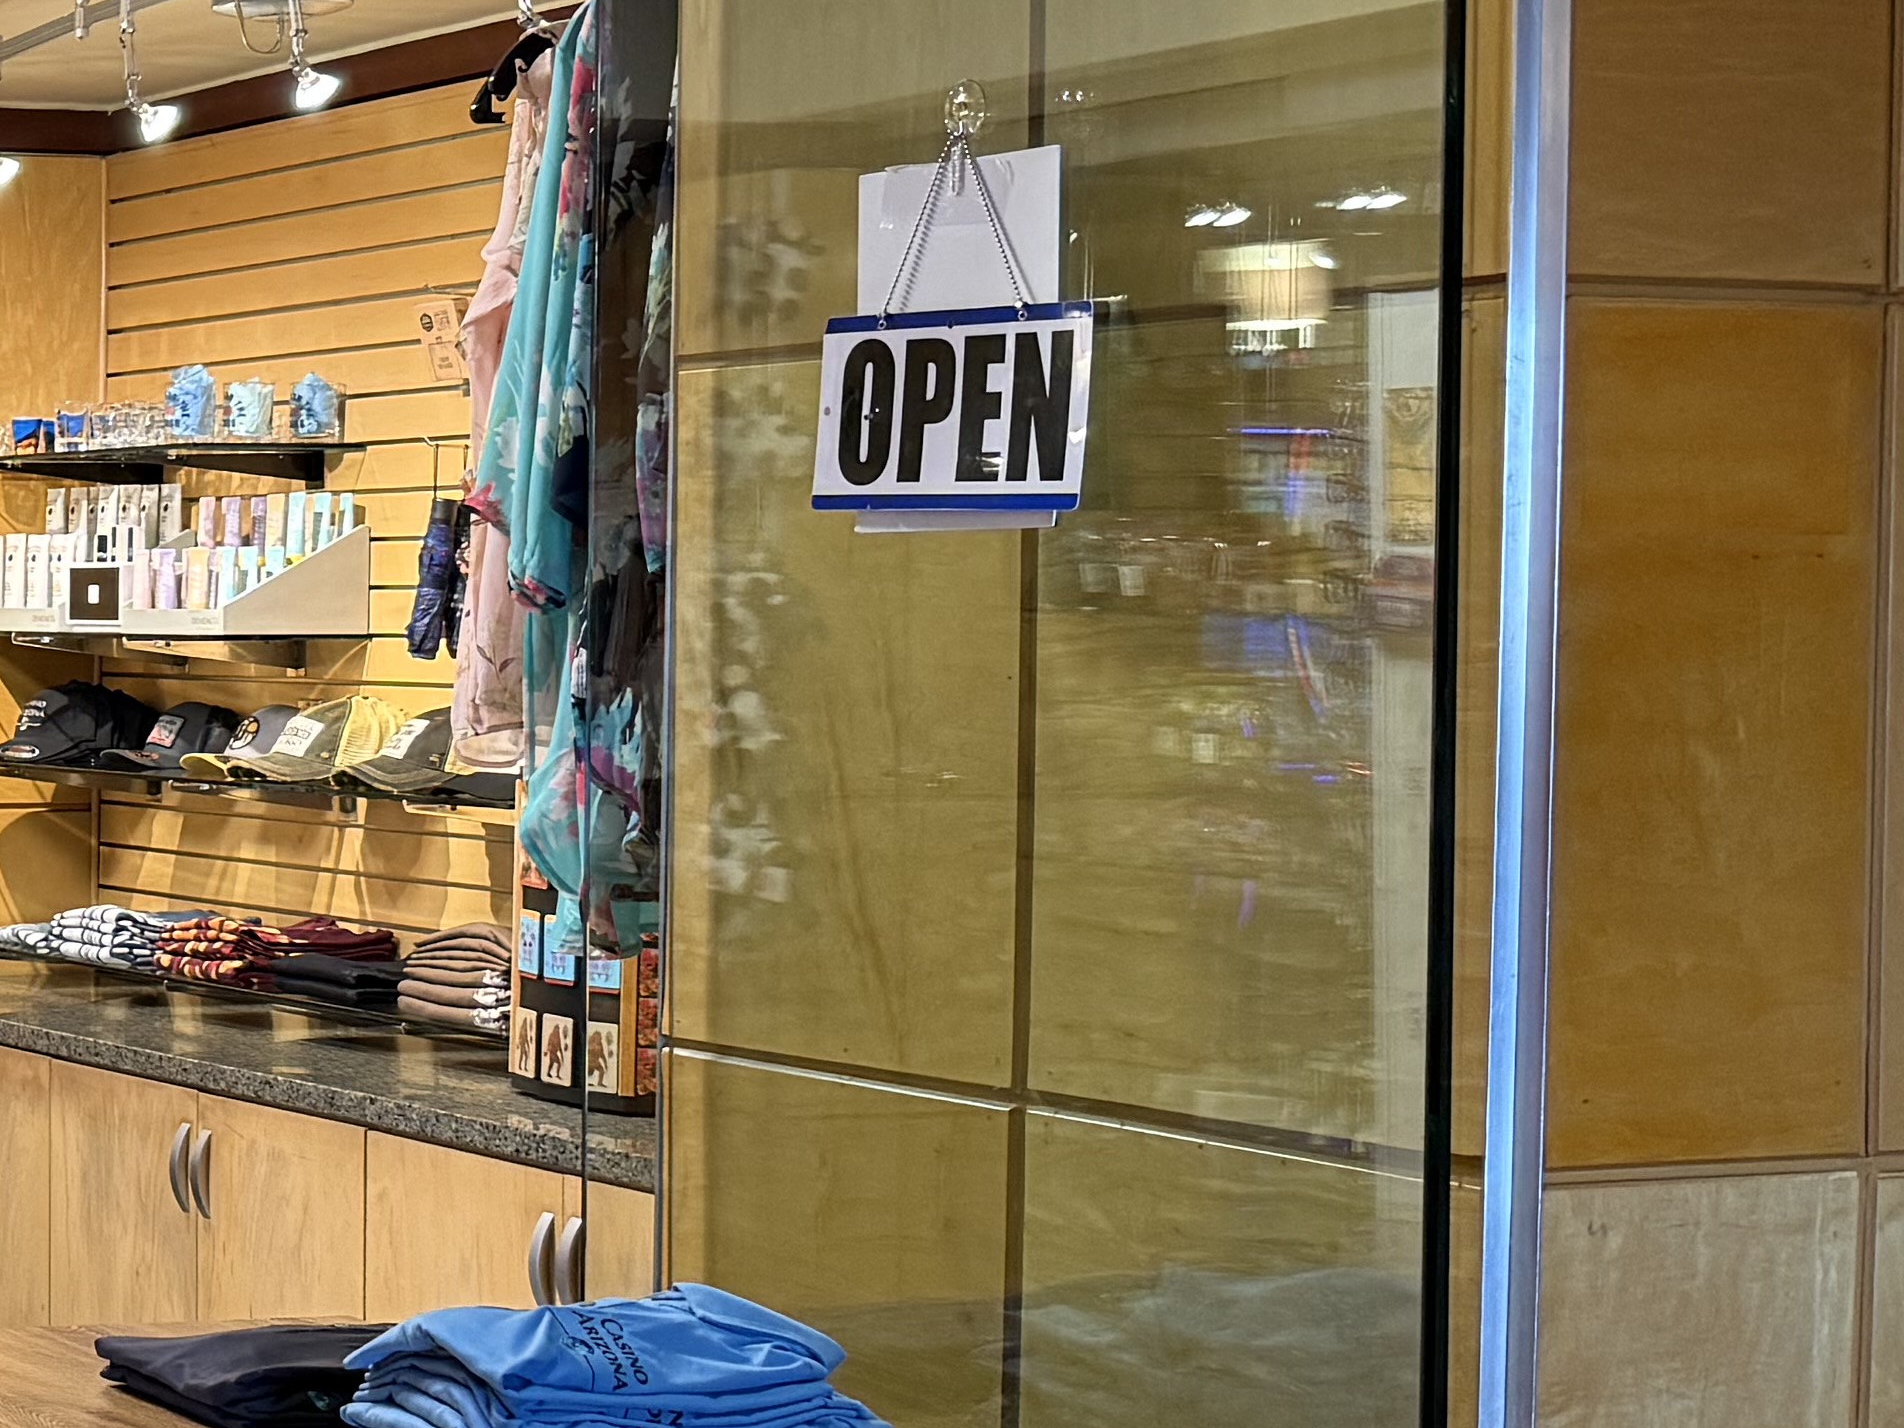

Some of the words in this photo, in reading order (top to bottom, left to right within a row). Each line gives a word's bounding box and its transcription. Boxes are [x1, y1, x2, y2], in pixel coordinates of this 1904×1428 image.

[838, 329, 1074, 486] OPEN
[572, 1310, 629, 1392] ARIZONA
[600, 1318, 649, 1386] CASINO
